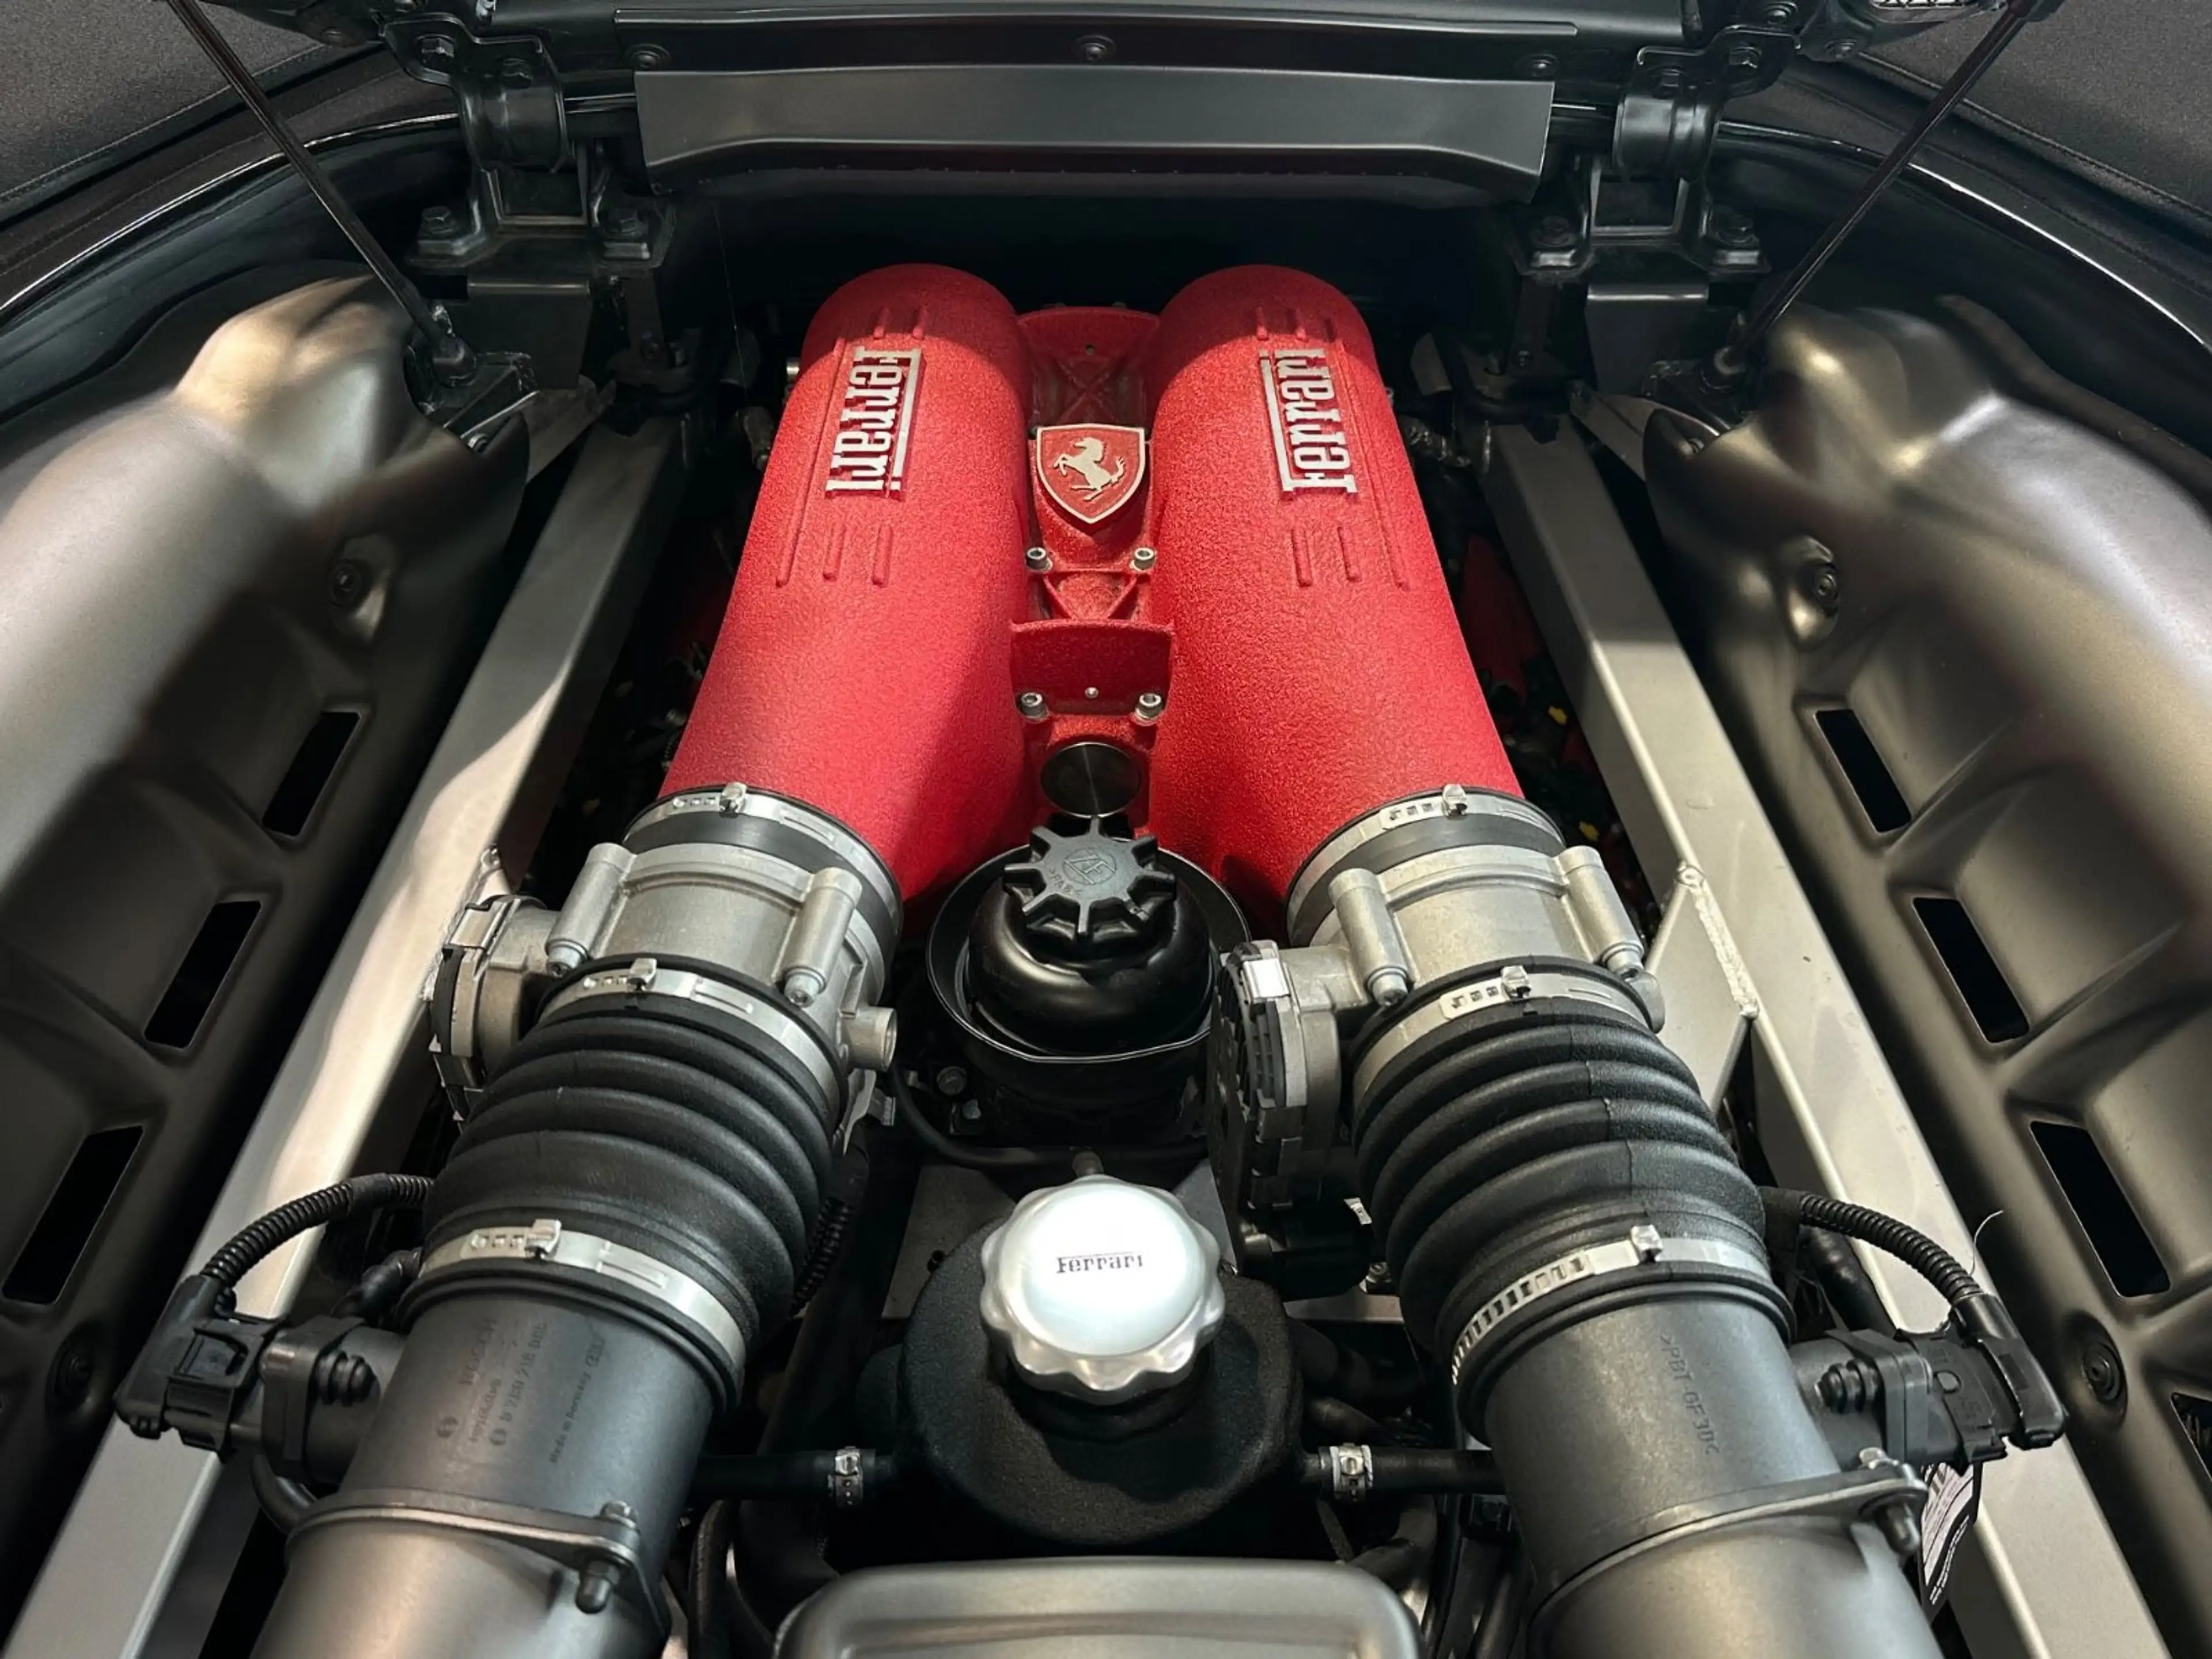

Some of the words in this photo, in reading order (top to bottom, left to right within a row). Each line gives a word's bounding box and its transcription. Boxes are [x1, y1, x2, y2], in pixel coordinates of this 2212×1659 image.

[825, 347, 922, 491] Ferrari
[1259, 349, 1358, 493] Ferrari
[1056, 1251, 1143, 1274] Ferrari
